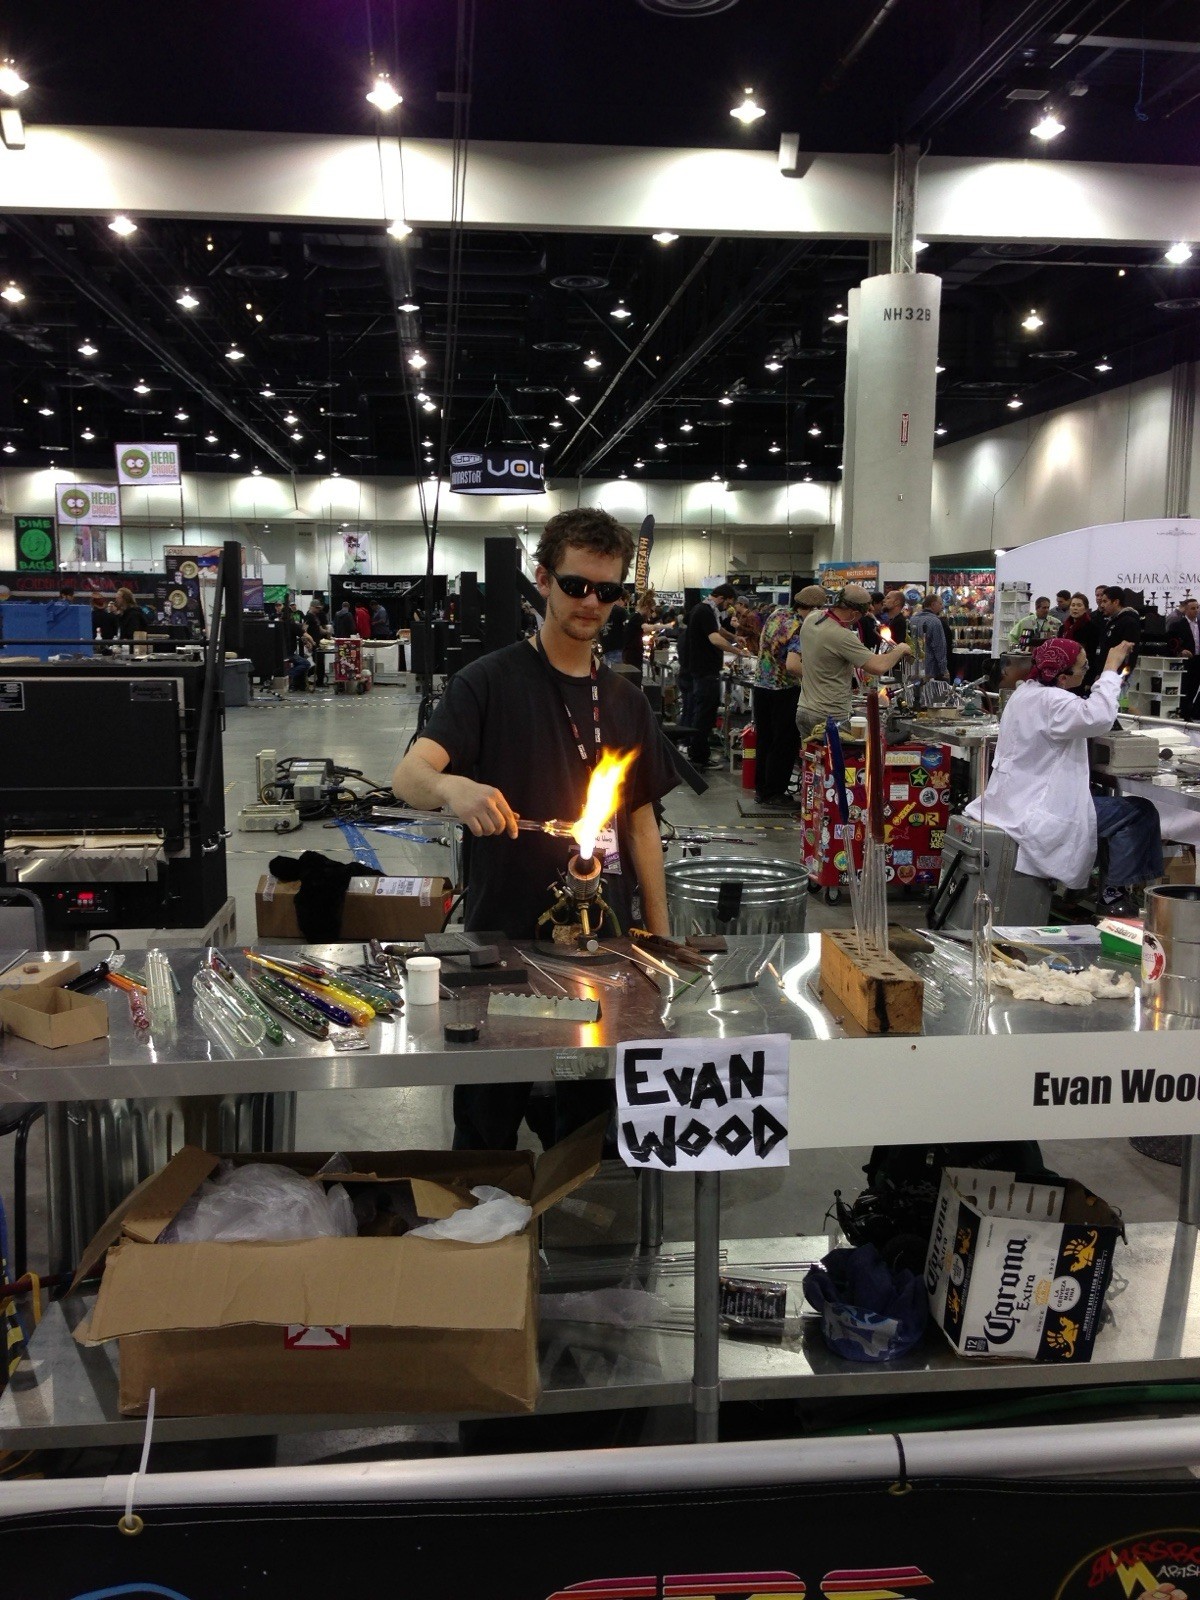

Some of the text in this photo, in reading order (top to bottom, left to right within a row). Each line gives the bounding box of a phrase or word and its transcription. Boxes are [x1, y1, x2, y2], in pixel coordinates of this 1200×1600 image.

[150, 451, 176, 465] HEAD
[91, 491, 116, 505] HEAD
[18, 518, 51, 529] DIME
[19, 561, 55, 570] BAGS
[1117, 573, 1170, 584] SAHARA
[343, 581, 411, 591] GLASSLAB
[1033, 1069, 1200, 1106] Evan Woo
[621, 1104, 789, 1168] WOOD
[983, 1237, 1028, 1345] Corona
[1016, 1274, 1036, 1312] Extra
[1053, 1289, 1060, 1299] LA
[1057, 1279, 1067, 1308] CERVEZA
[966, 1338, 979, 1350] 12
